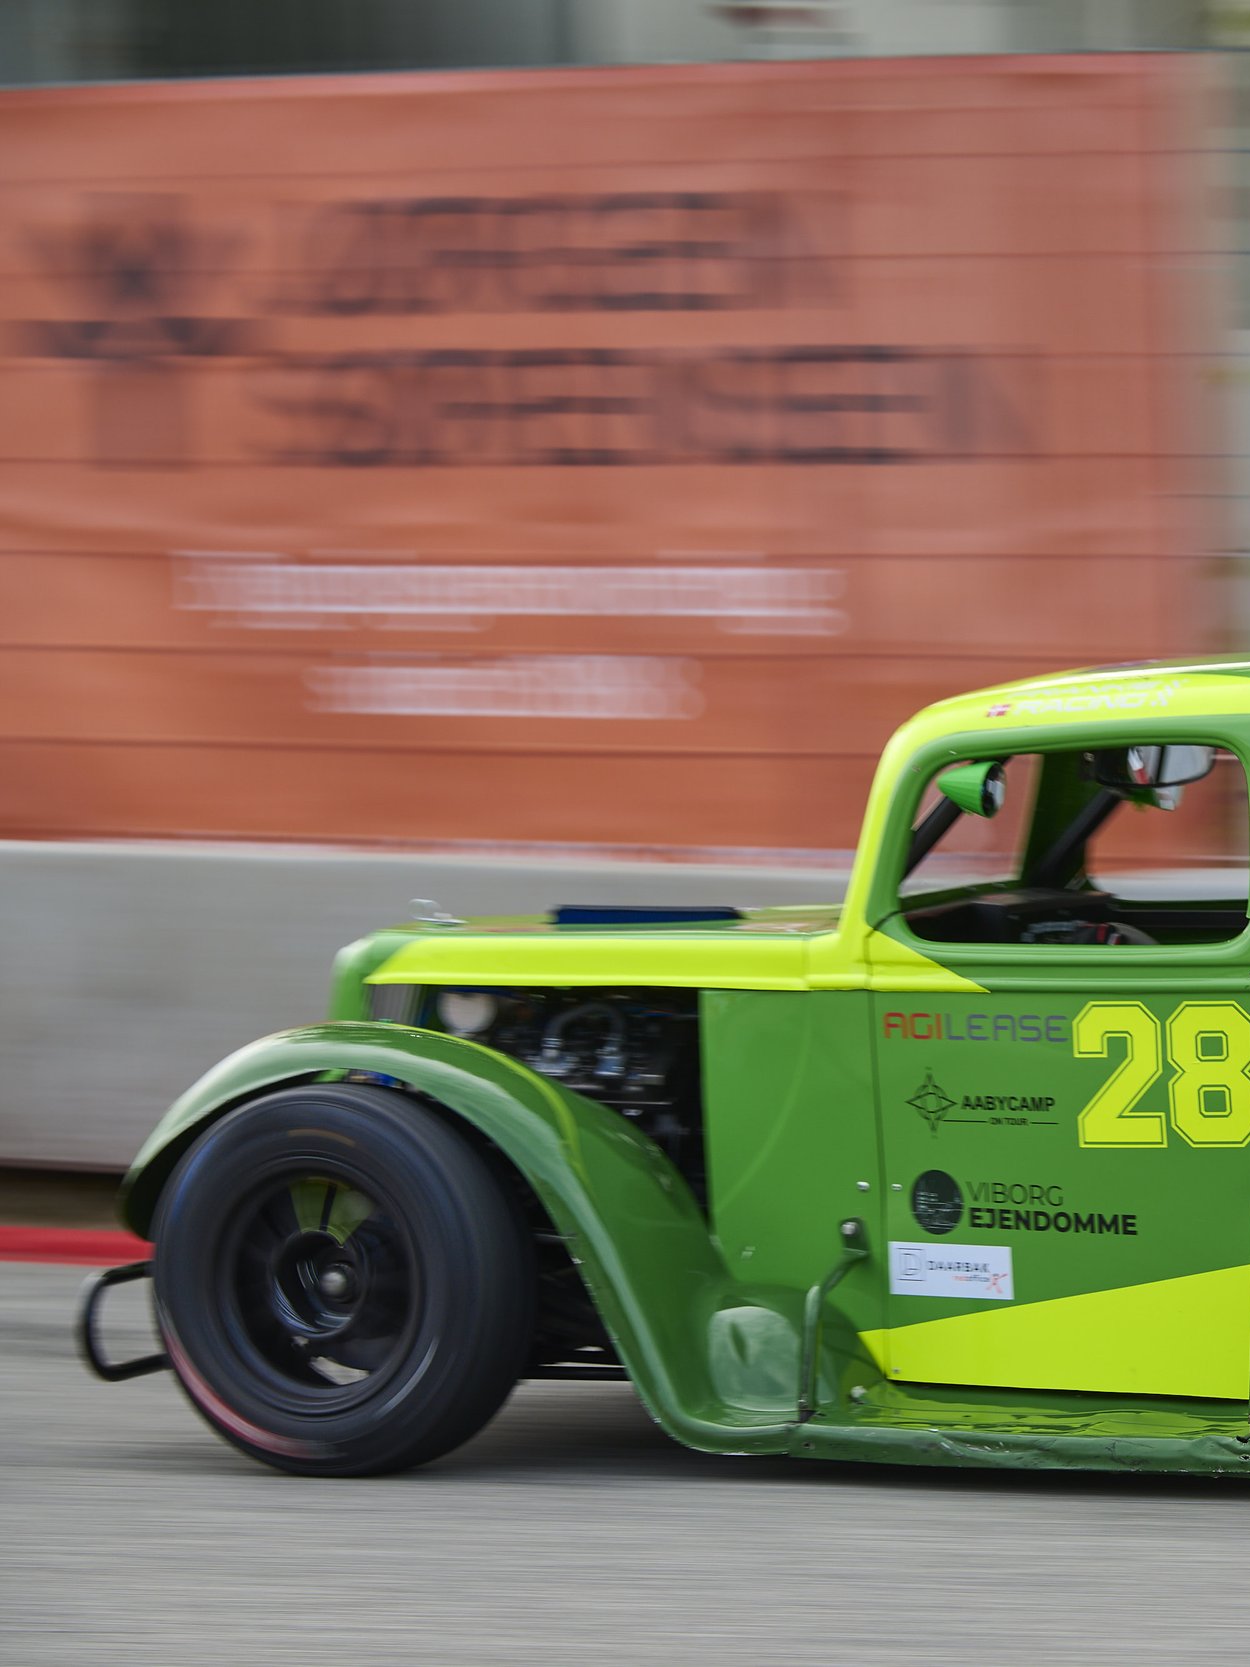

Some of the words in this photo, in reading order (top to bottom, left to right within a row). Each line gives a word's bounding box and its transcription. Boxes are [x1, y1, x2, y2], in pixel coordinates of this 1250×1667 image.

[882, 1011, 1069, 1043] AGILEASE
[961, 1094, 1056, 1112] AABYCAMP
[1003, 1117, 1030, 1127] TOUR
[965, 1180, 1065, 1207] VIBORG
[969, 1206, 1139, 1236] EJENDOMME
